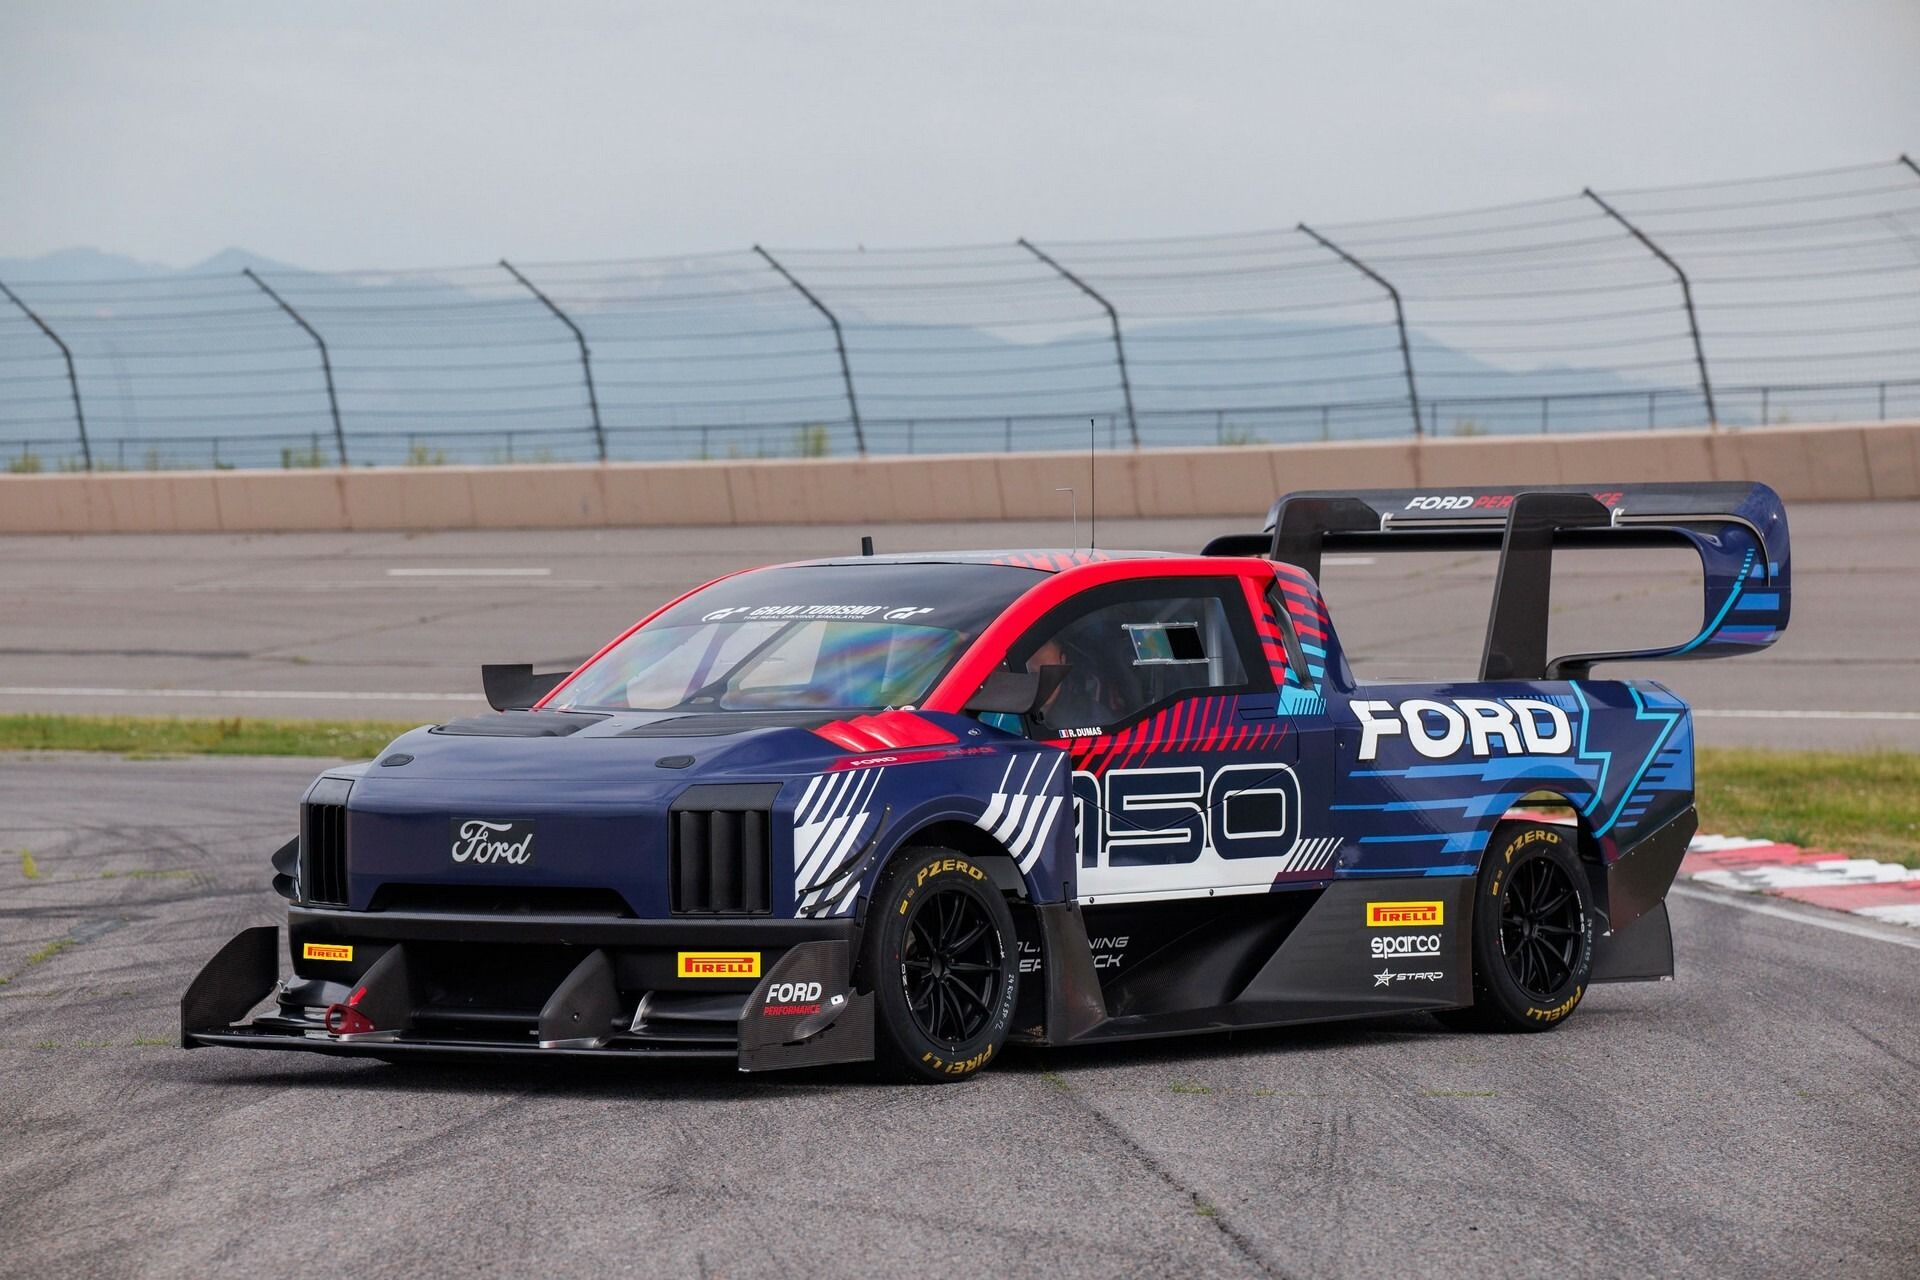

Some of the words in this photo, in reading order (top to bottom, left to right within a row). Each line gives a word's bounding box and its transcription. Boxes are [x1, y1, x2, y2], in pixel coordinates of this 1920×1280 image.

[1405, 496, 1474, 510] FORD
[750, 606, 804, 616] GRAN
[1076, 727, 1102, 737] DUMAS
[1349, 699, 1573, 760] FORD
[849, 756, 898, 767] FORD
[452, 820, 533, 865] Ford
[1373, 906, 1437, 922] PIRELLI
[307, 946, 349, 959] PIRELLI
[685, 957, 754, 972] PIRELLI
[1396, 972, 1444, 982] STARD
[765, 982, 823, 1003] FORD
[763, 1004, 822, 1016] PERFORMANCE
[1526, 985, 1583, 1021] PIRELLI
